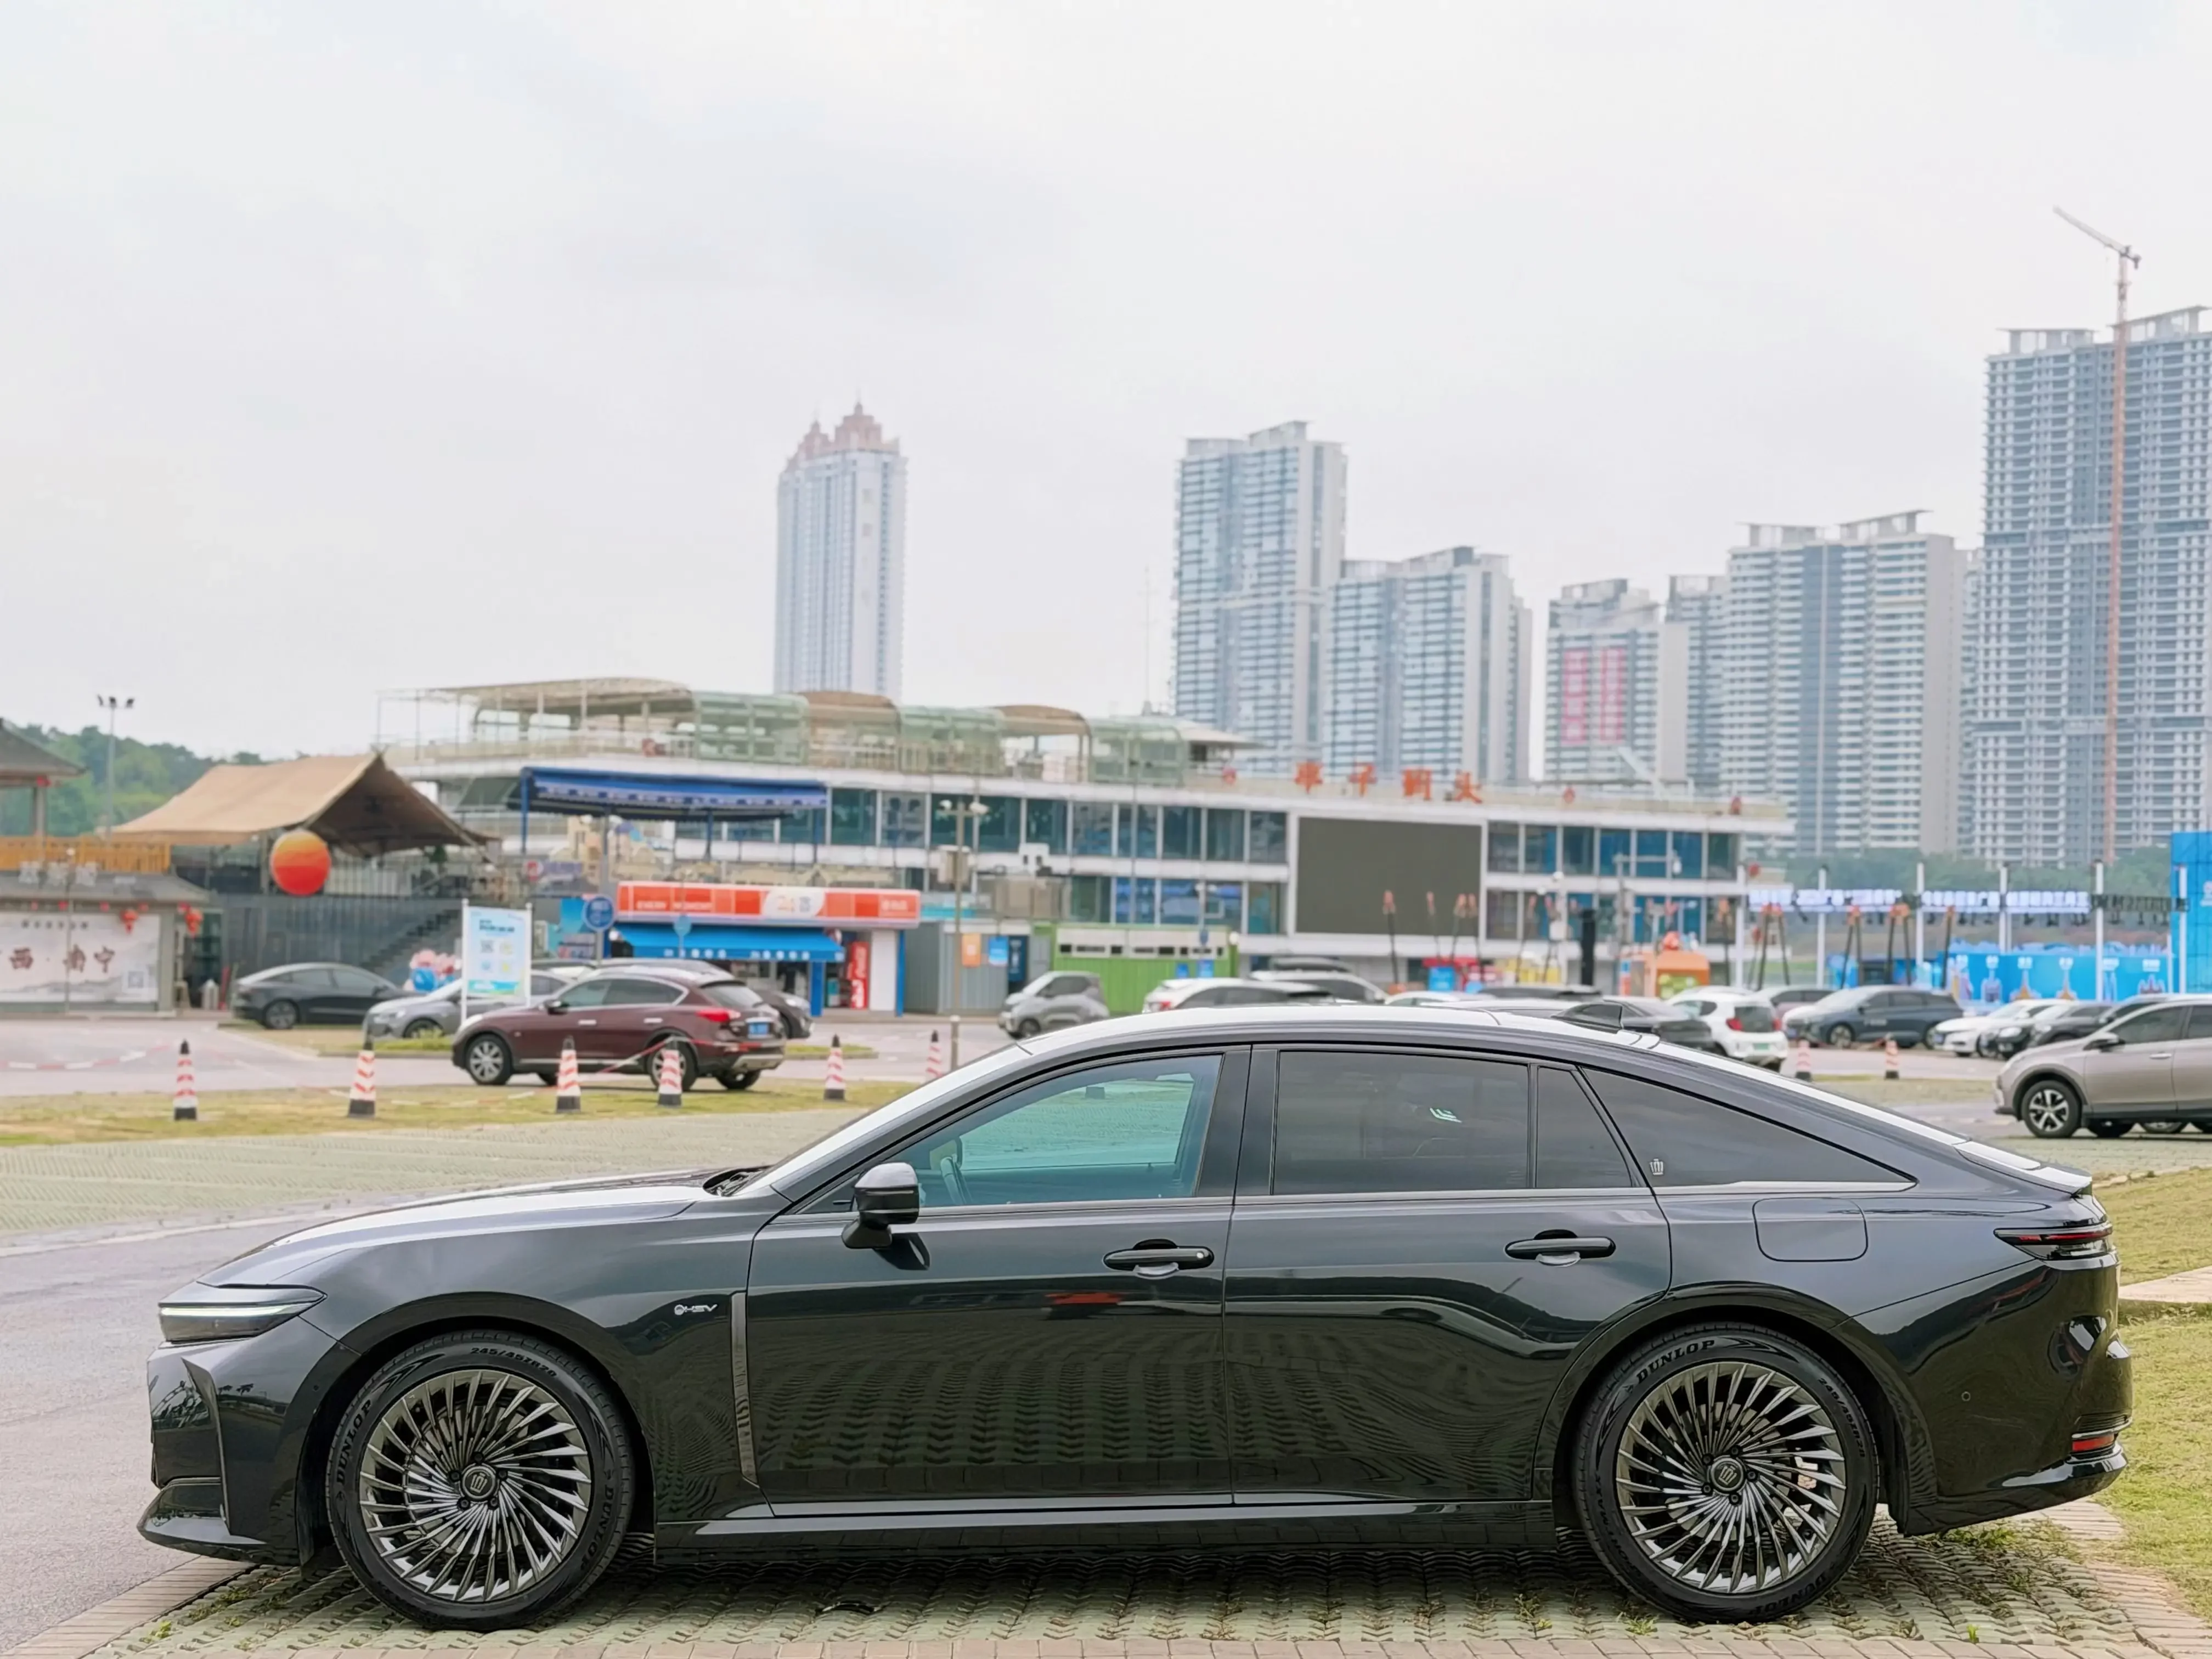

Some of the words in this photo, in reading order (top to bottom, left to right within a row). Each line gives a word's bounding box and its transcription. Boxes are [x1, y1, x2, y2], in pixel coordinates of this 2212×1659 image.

[1637, 1340, 1715, 1384] DUNLOP
[336, 1400, 371, 1485] DUNLOP
[580, 1484, 614, 1571] DUNLOP
